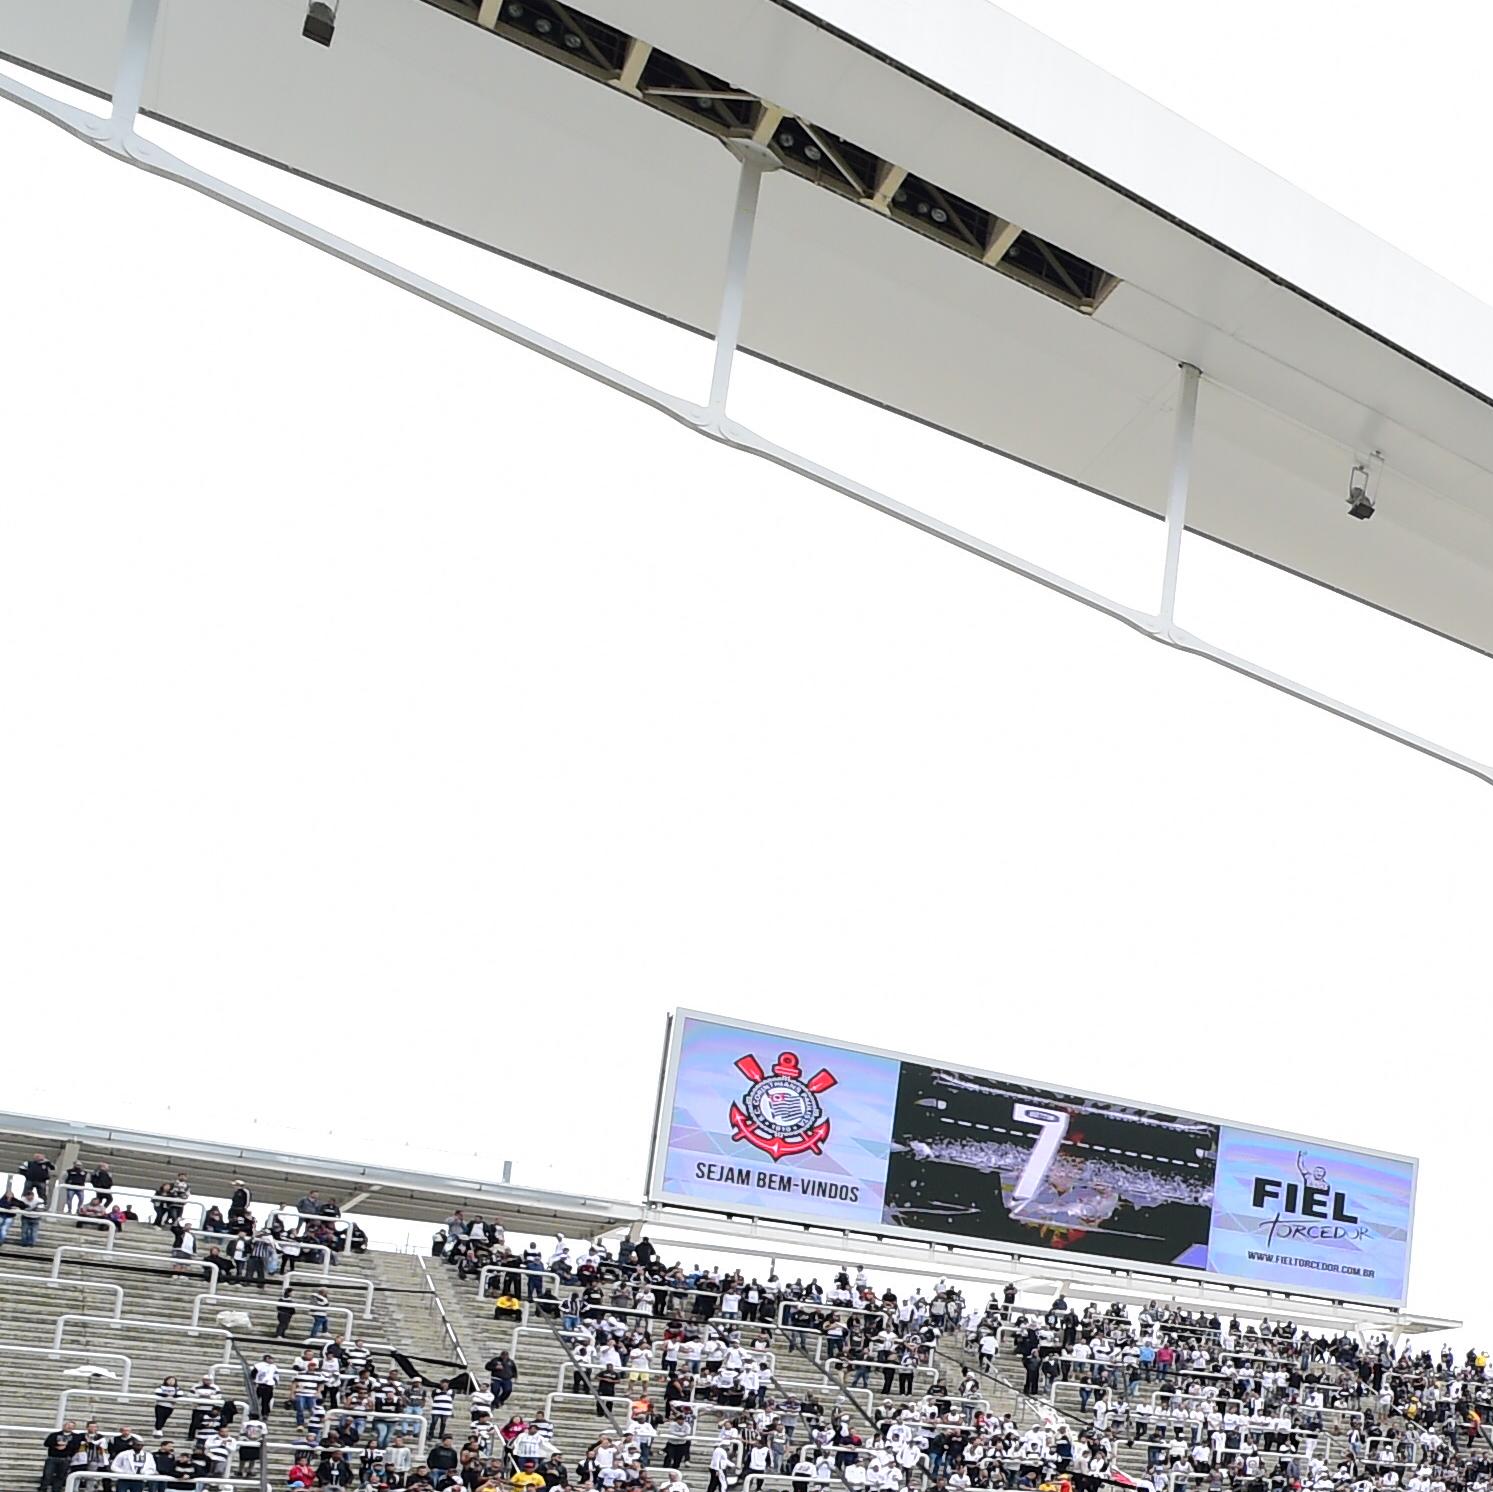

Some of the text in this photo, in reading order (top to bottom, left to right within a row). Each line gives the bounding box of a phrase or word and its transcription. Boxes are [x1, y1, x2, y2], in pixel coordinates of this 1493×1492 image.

[696, 1162, 860, 1203] SEJAM BEM-VINDOS
[1252, 1177, 1358, 1224] FIEL
[1248, 1251, 1375, 1278] WWW.FIELTORCEDOR.COM.BR
